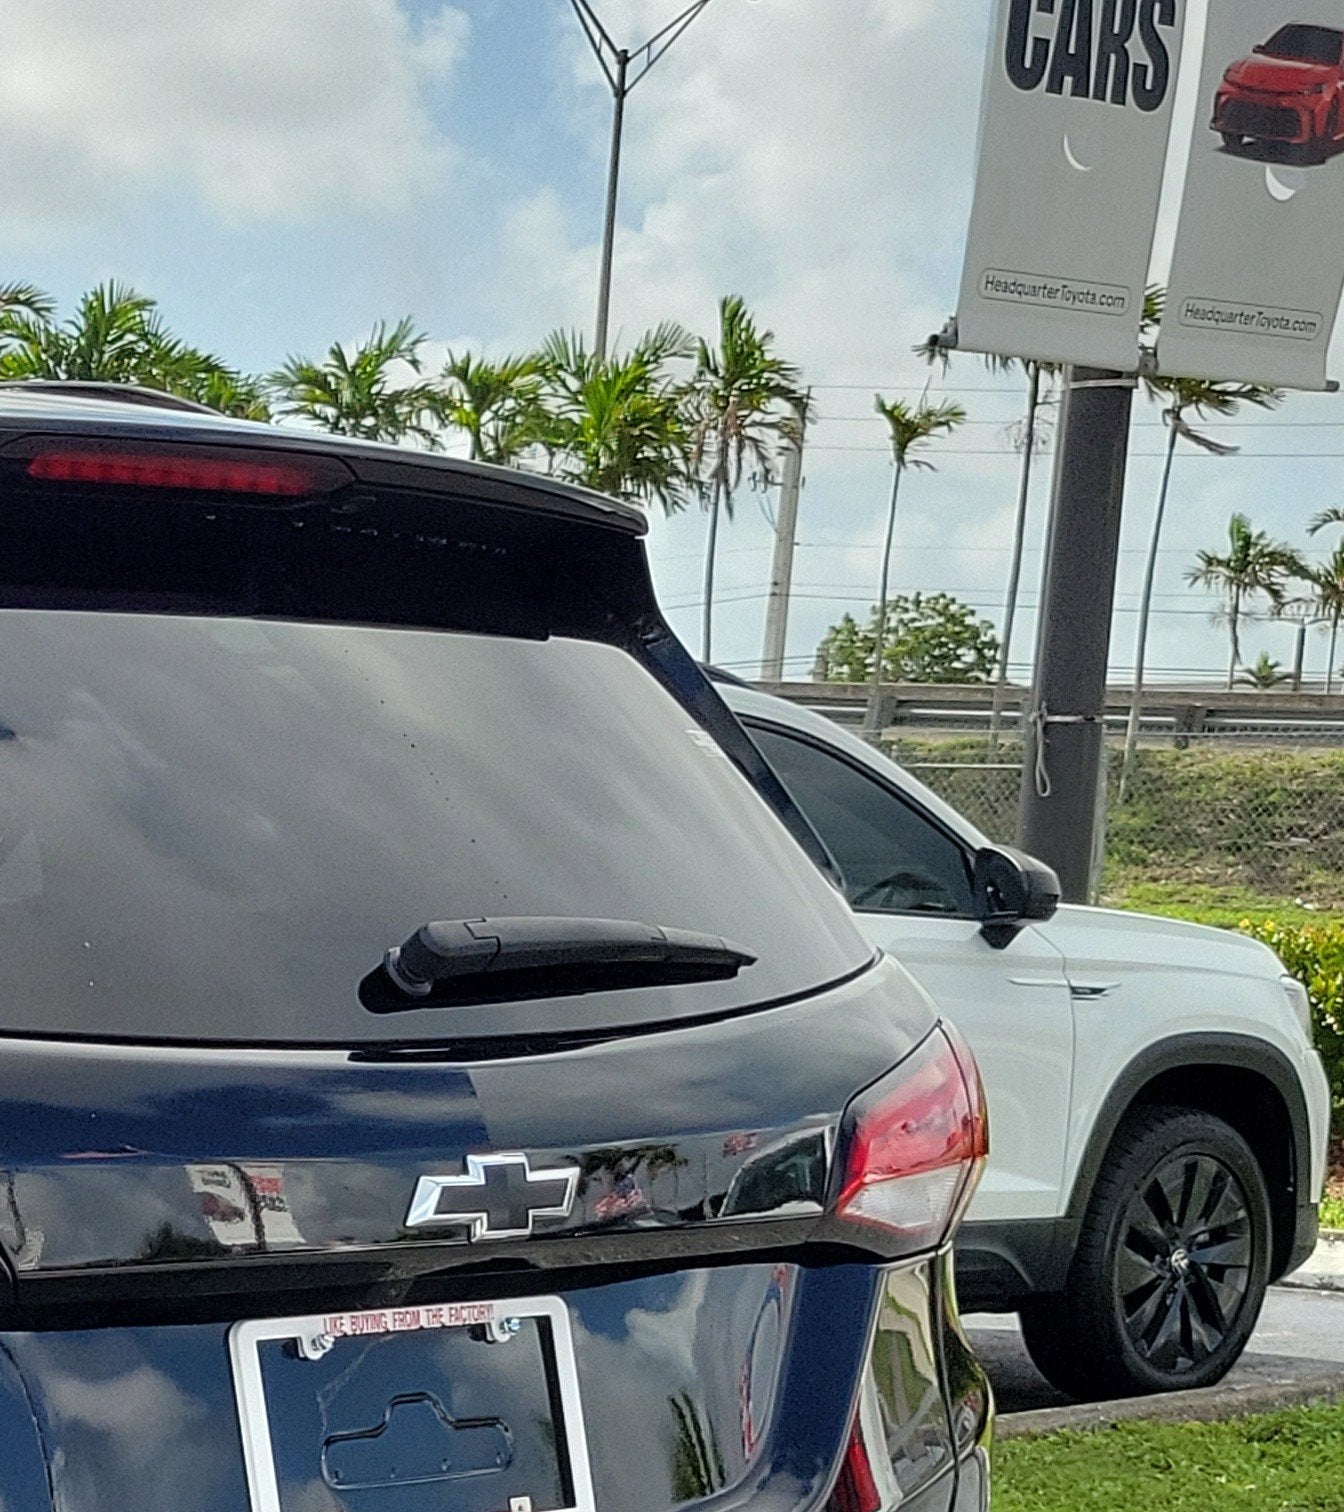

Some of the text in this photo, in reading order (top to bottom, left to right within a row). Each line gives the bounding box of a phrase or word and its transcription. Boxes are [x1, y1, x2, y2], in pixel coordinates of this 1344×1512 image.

[1005, 0, 1176, 112] CARS
[984, 274, 1127, 310] HeadquarterToyota.com
[1184, 303, 1317, 335] HeadquarterToyota.com
[324, 1316, 345, 1335] LIKE
[350, 1313, 388, 1333] BUYING
[393, 1309, 421, 1329] FROM
[427, 1307, 444, 1325] THE
